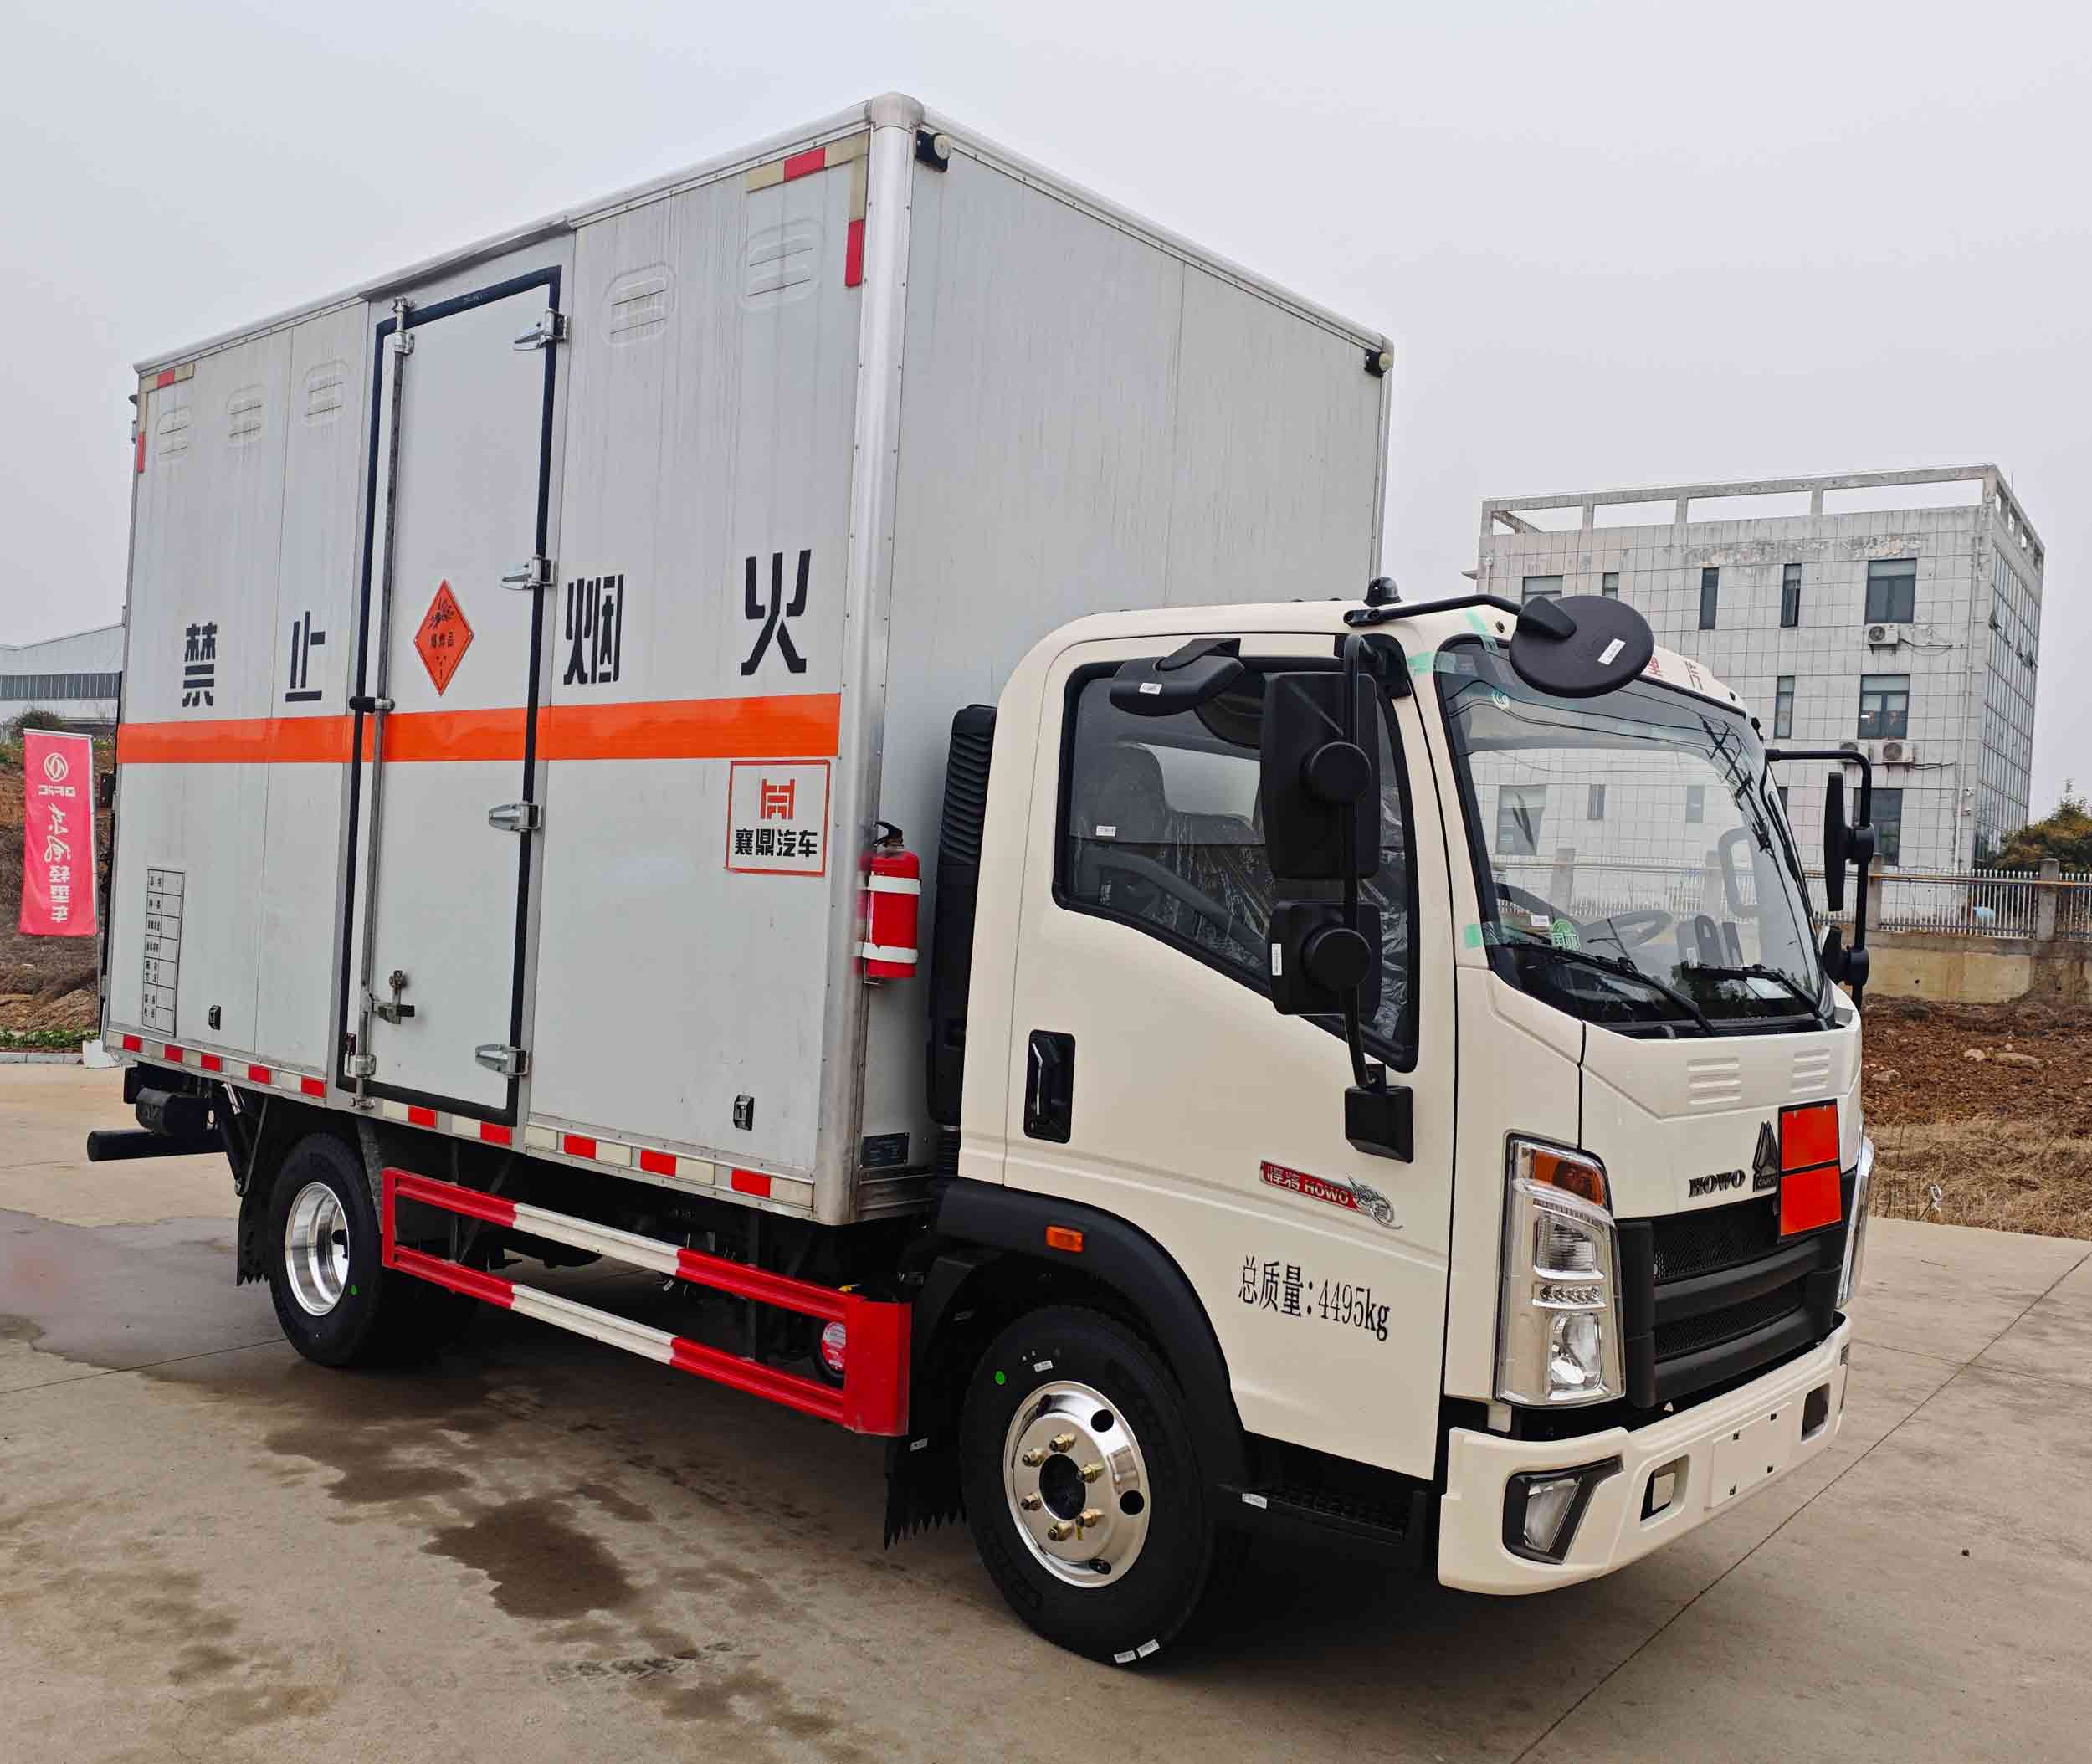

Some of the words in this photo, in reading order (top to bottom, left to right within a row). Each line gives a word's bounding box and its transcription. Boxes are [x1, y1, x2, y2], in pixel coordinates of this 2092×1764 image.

[735, 828, 818, 857] 襄鼎汽车
[1304, 1178, 1350, 1205] HOWO
[1689, 1169, 1746, 1197] HOWO
